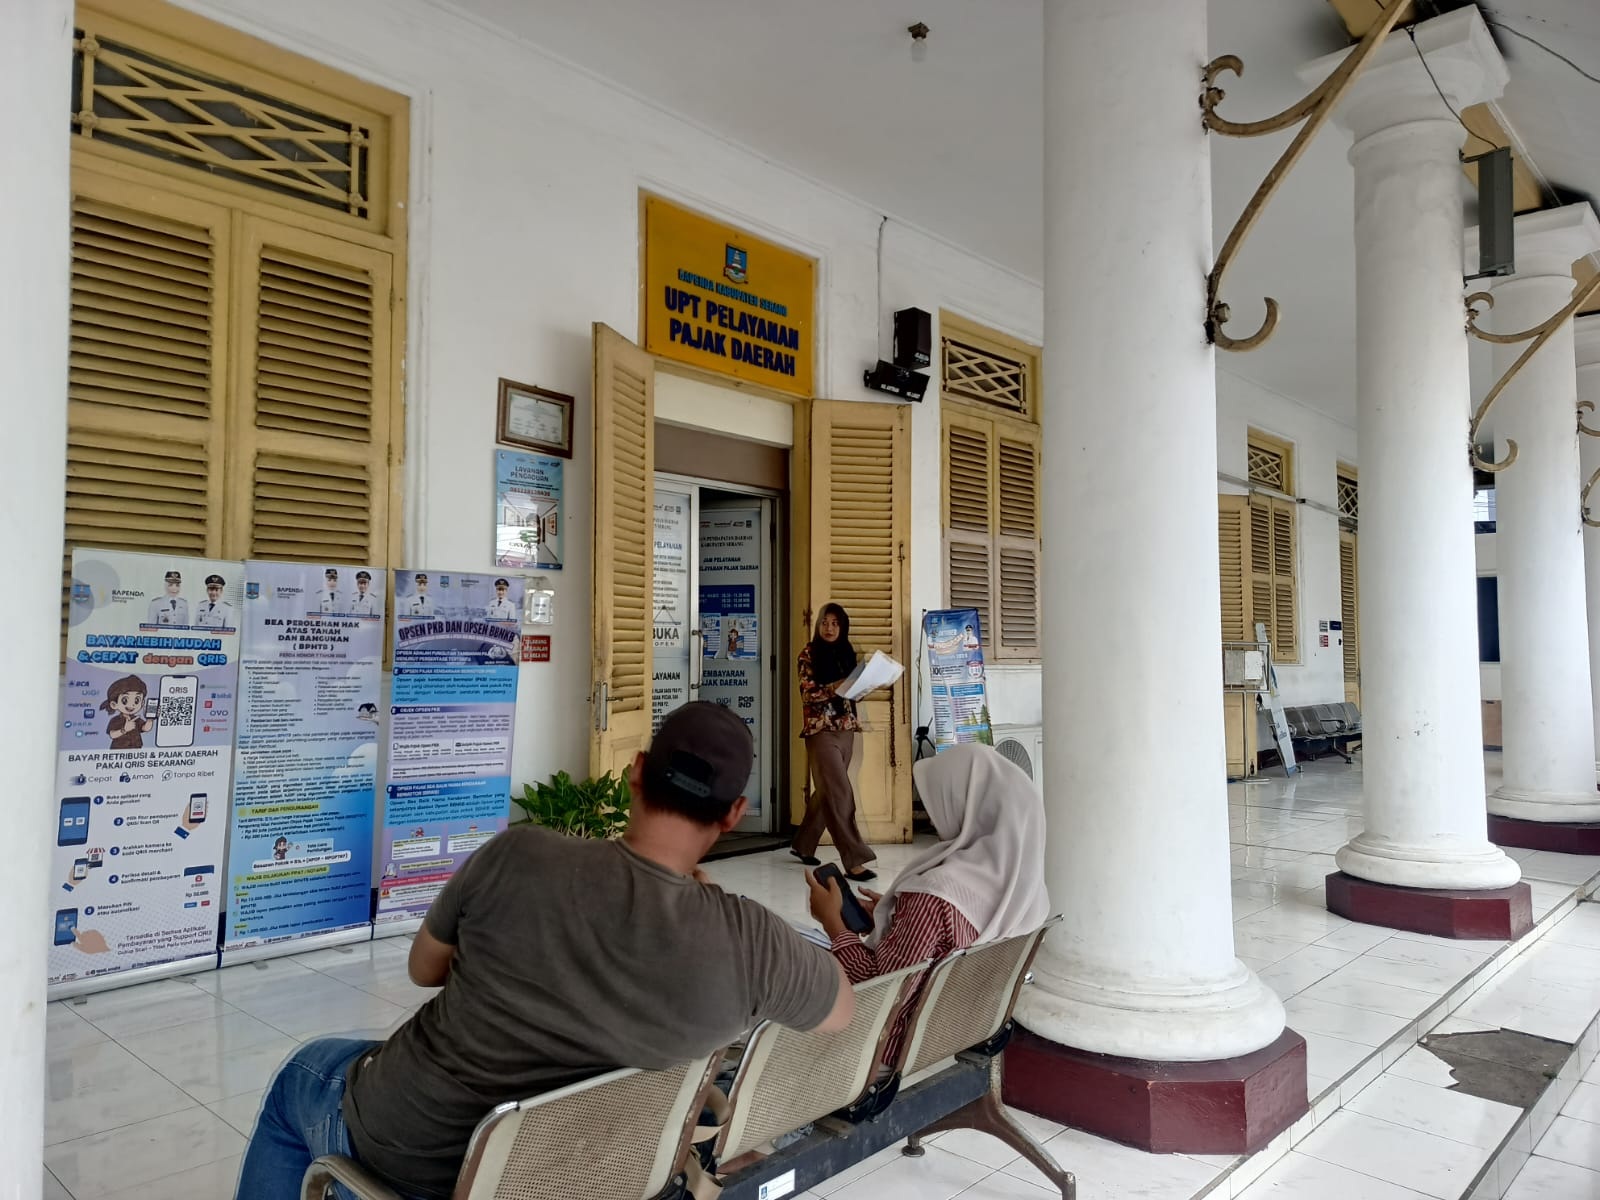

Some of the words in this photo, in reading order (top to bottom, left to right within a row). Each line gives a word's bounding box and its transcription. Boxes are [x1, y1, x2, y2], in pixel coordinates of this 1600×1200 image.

[716, 282, 758, 307] KABUPATEN
[760, 298, 787, 317] SERANG
[665, 286, 701, 318] UPT
[706, 300, 799, 351] PELAYANAN
[670, 318, 726, 357] PAJAK
[731, 337, 795, 376] DAERAH
[399, 624, 426, 640] OPSEN
[427, 621, 443, 634] PKB
[446, 621, 462, 633] DAN
[464, 622, 488, 635] OPSEN
[489, 625, 515, 642] BBNKB
[653, 628, 679, 640] UKA
[86, 634, 135, 647] BAYAR
[137, 636, 172, 648] LEBIH
[175, 637, 221, 650] MUDAH
[91, 651, 139, 664] CEPAT
[142, 652, 193, 667] dengan
[198, 654, 227, 666] QRIS
[96, 761, 123, 770] PAKAI
[125, 761, 145, 769] QRIS
[147, 759, 196, 768] SEKARANG!
[102, 752, 148, 761] RETRIBUSI
[88, 775, 112, 783] Cepat
[174, 771, 196, 779] Tanpa
[126, 932, 153, 940] Tersedia
